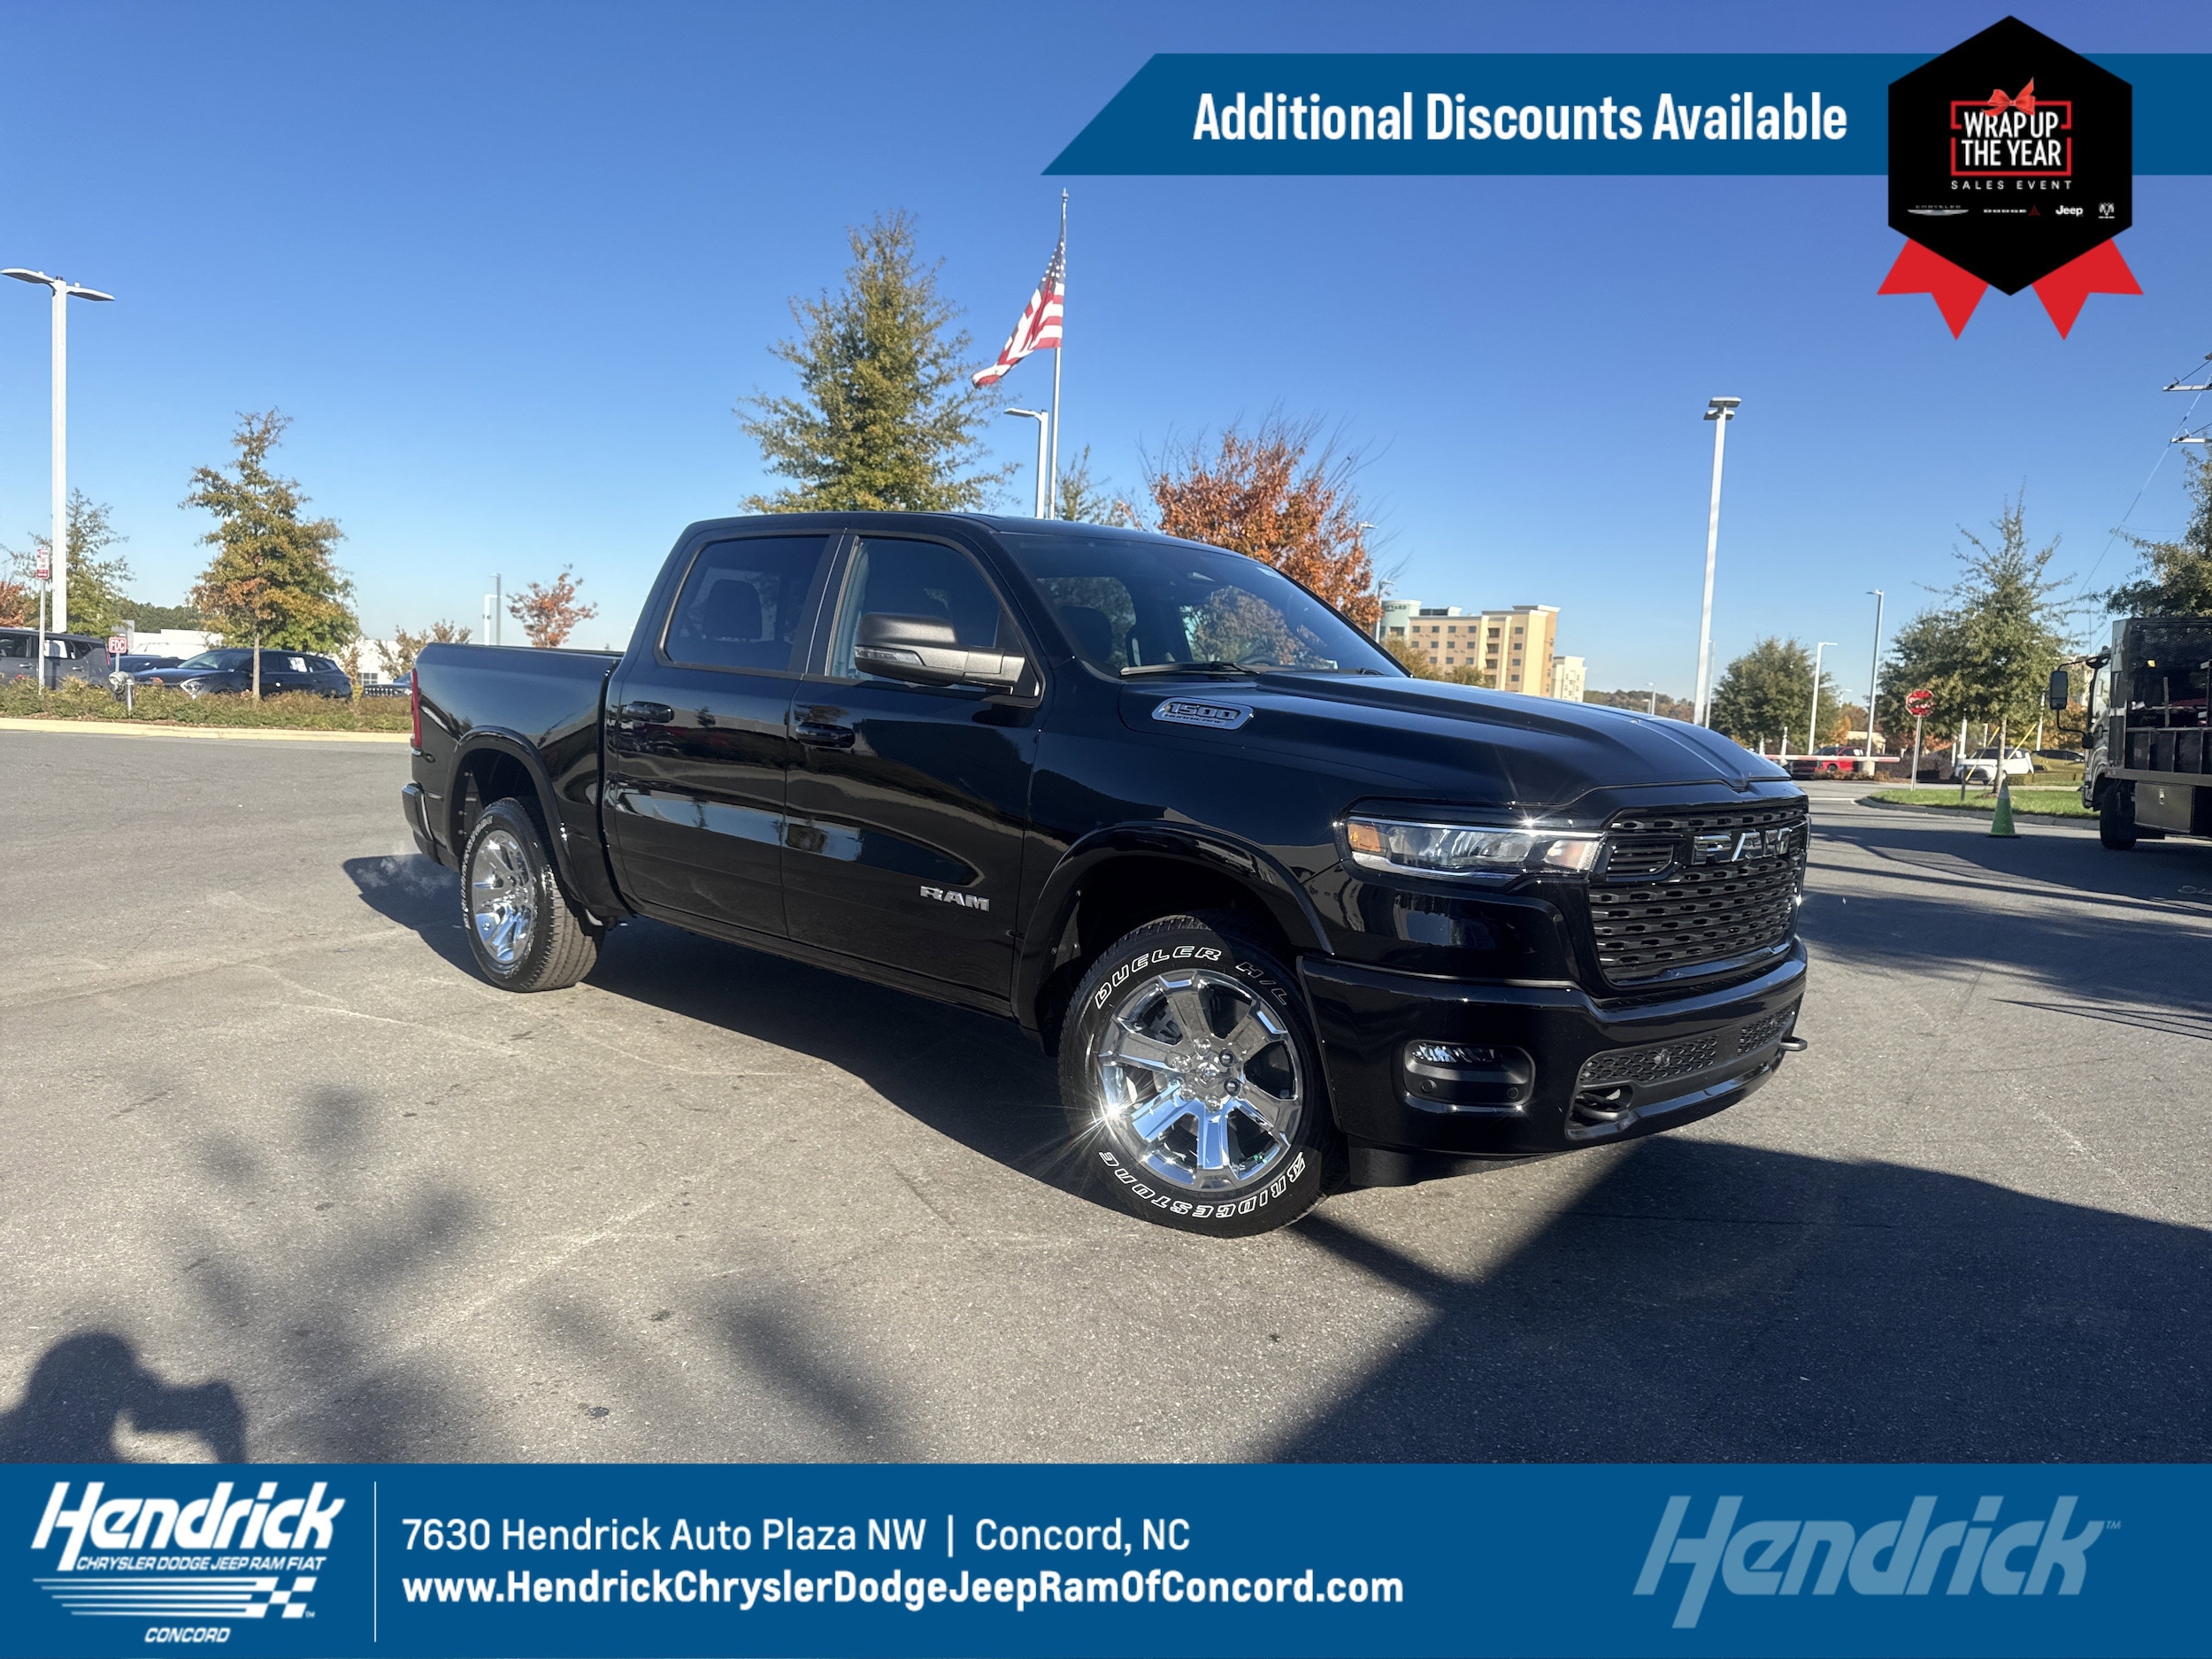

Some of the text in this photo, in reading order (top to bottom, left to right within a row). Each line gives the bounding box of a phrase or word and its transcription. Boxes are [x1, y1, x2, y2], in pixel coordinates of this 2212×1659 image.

[111, 640, 125, 651] FDC
[1169, 703, 1239, 721] 1500
[920, 886, 990, 912] RAM
[1094, 945, 1223, 1010] DUELER
[1098, 1151, 1307, 1218] BRIDGESTONE
